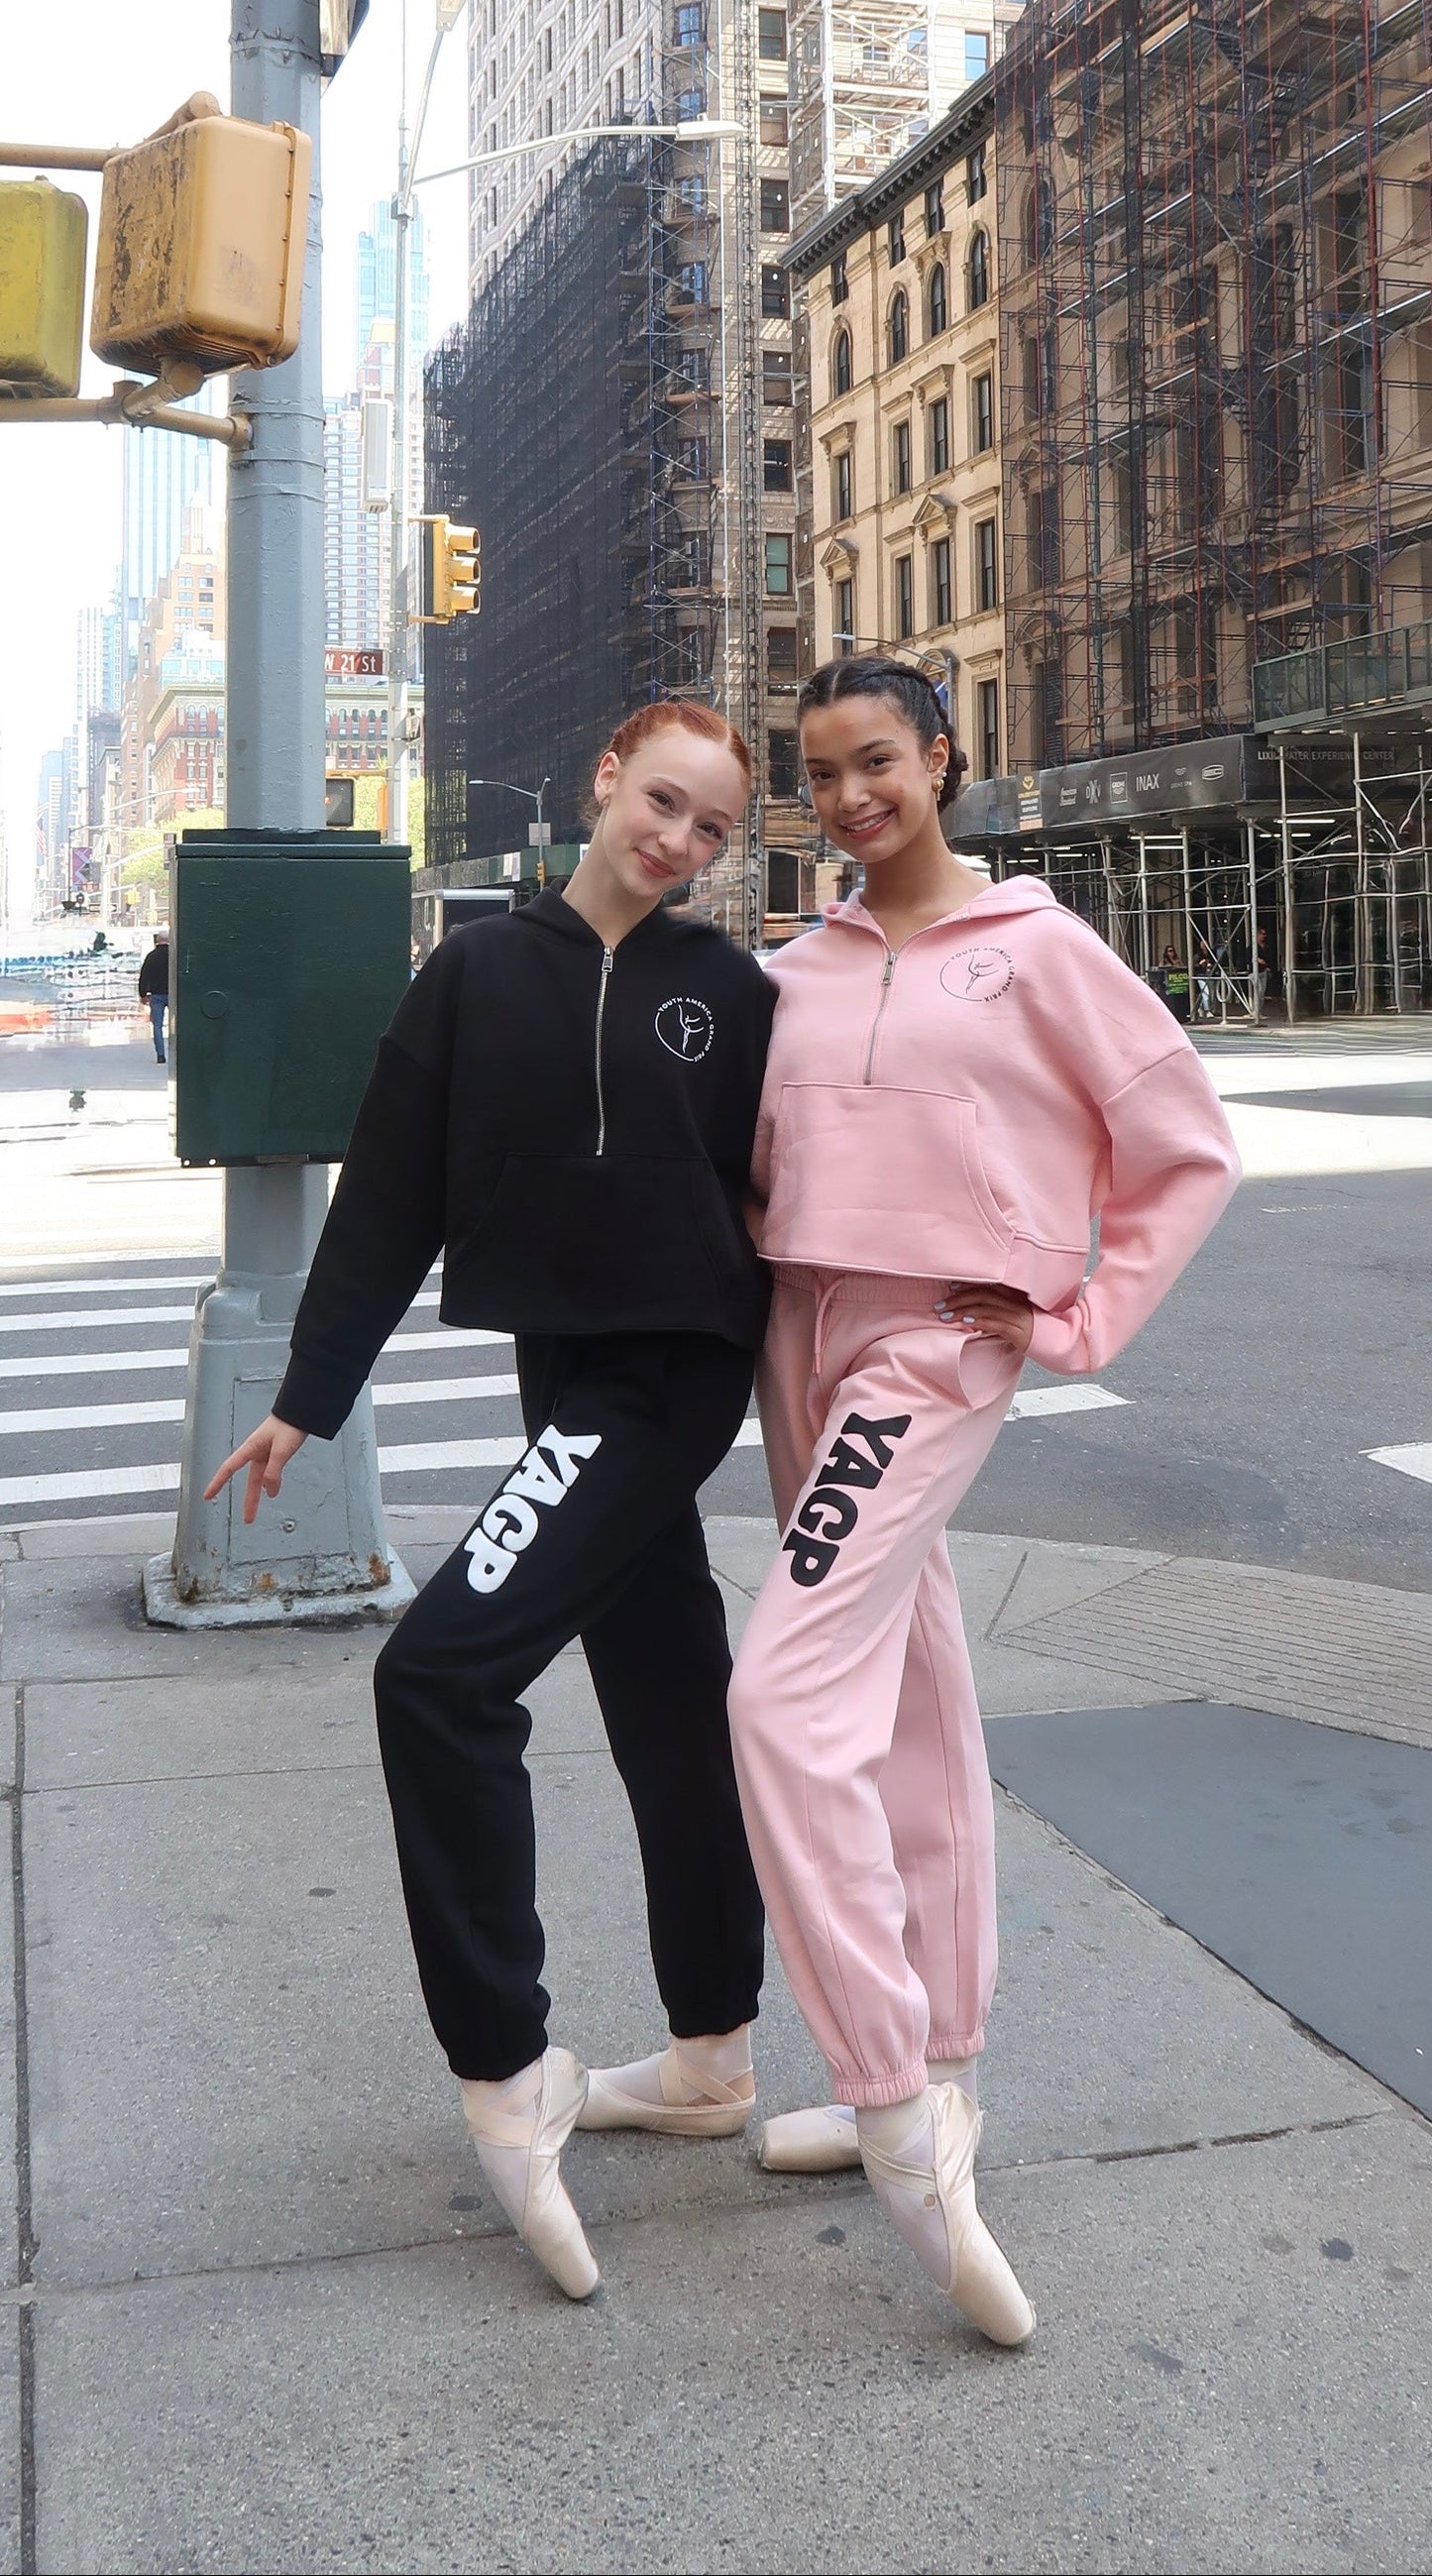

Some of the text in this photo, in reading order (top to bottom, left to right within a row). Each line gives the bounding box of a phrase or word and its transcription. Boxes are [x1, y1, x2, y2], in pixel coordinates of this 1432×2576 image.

[341, 654, 355, 672] 21
[362, 655, 377, 672] St
[1136, 773, 1159, 792] INAX
[950, 947, 1015, 1002] YOUTH AMERICA GRAND PRIX
[657, 996, 684, 1012] YOUTH
[686, 997, 713, 1022] AMERICA
[705, 1024, 715, 1052] GRAND
[464, 1423, 603, 1594] YAGP
[781, 1411, 912, 1587] YAGP
